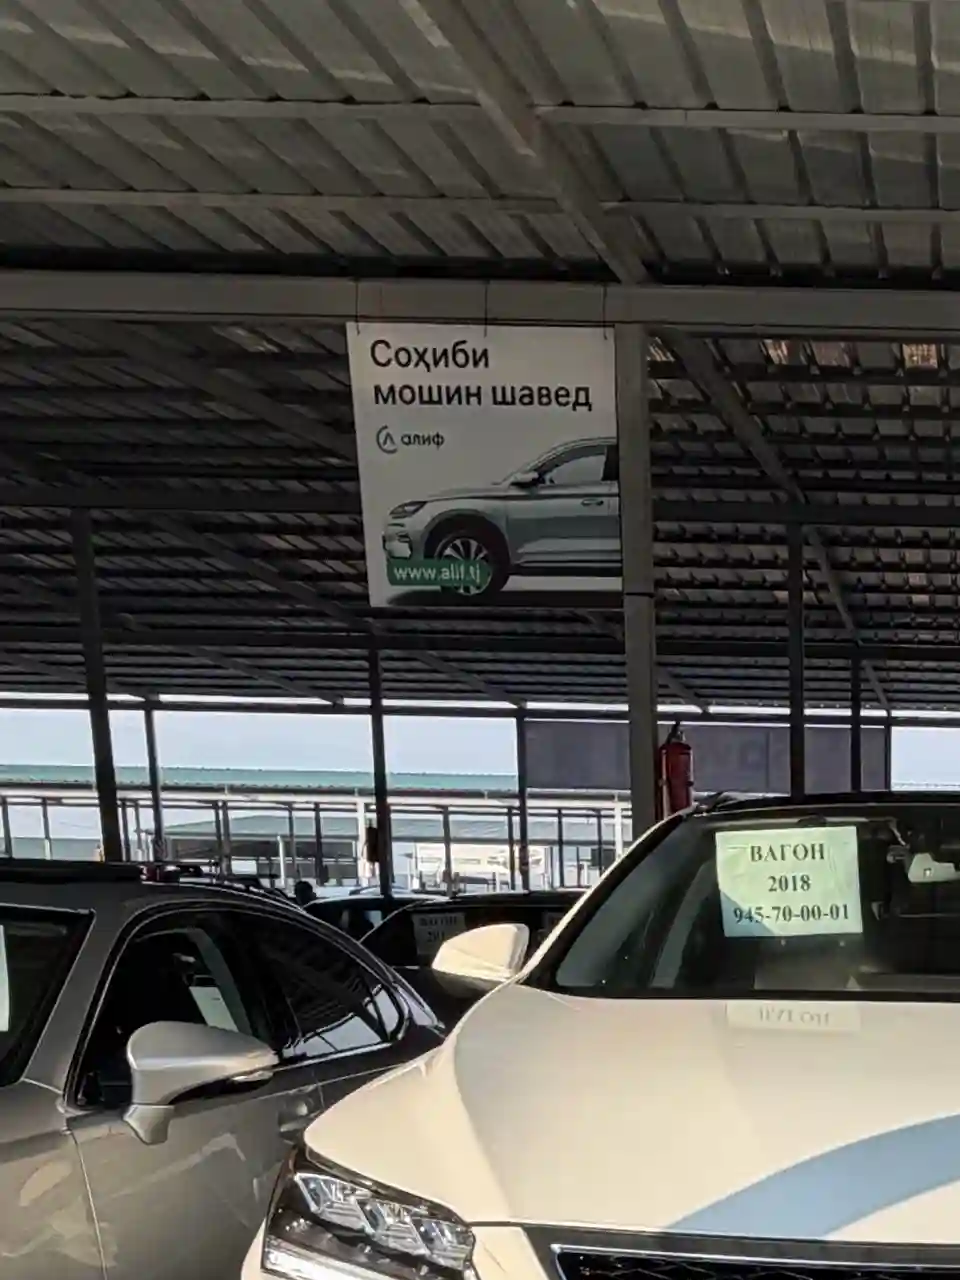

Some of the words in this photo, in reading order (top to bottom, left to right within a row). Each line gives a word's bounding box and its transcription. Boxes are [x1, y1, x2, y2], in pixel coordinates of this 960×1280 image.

[370, 340, 490, 372] Соҳиби
[373, 384, 483, 406] мошин
[491, 385, 593, 411] шавед
[400, 431, 445, 450] алиф
[750, 843, 825, 862] ВАГОН
[768, 874, 811, 892] 2018
[733, 904, 849, 924] 945-70-00-01
